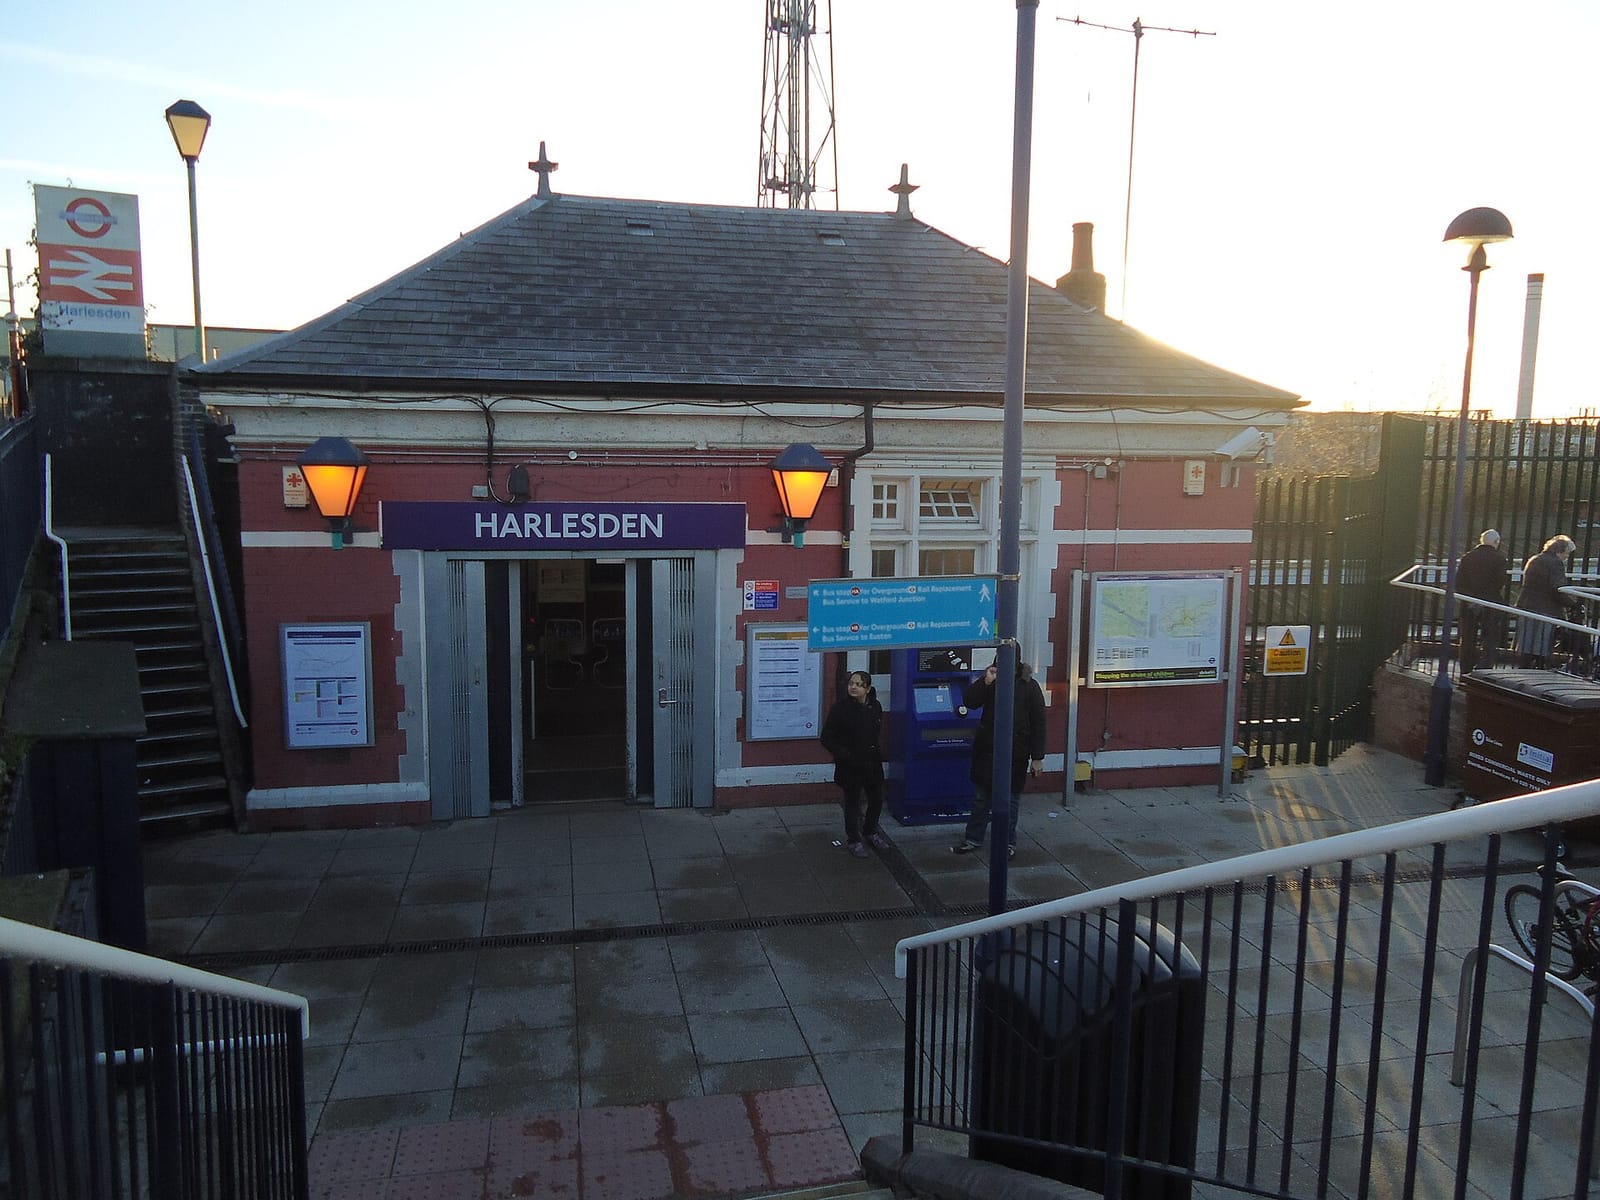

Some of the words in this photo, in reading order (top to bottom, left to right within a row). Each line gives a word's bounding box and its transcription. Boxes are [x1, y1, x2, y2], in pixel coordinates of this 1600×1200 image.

[59, 304, 131, 321] Harlesden
[474, 511, 663, 539] HARLESDEN
[823, 588, 835, 597] Bus
[836, 588, 851, 598] stop
[872, 586, 908, 596] Overground
[917, 585, 930, 593] Rail
[931, 584, 972, 594] Replacement
[823, 598, 835, 606] Bus
[836, 597, 860, 606] Service
[861, 597, 869, 605] to
[871, 596, 897, 604] Watford
[898, 595, 926, 603] Junction
[822, 625, 835, 633] Bus
[836, 625, 851, 634] stop
[871, 622, 908, 632] Overground
[917, 621, 930, 629] Rail
[931, 620, 971, 629] Replacement
[822, 635, 835, 643] Bus
[836, 634, 860, 642] Service
[869, 632, 893, 640] Euston
[1516, 770, 1536, 781] WASTE
[1535, 777, 1551, 786] ONLY
